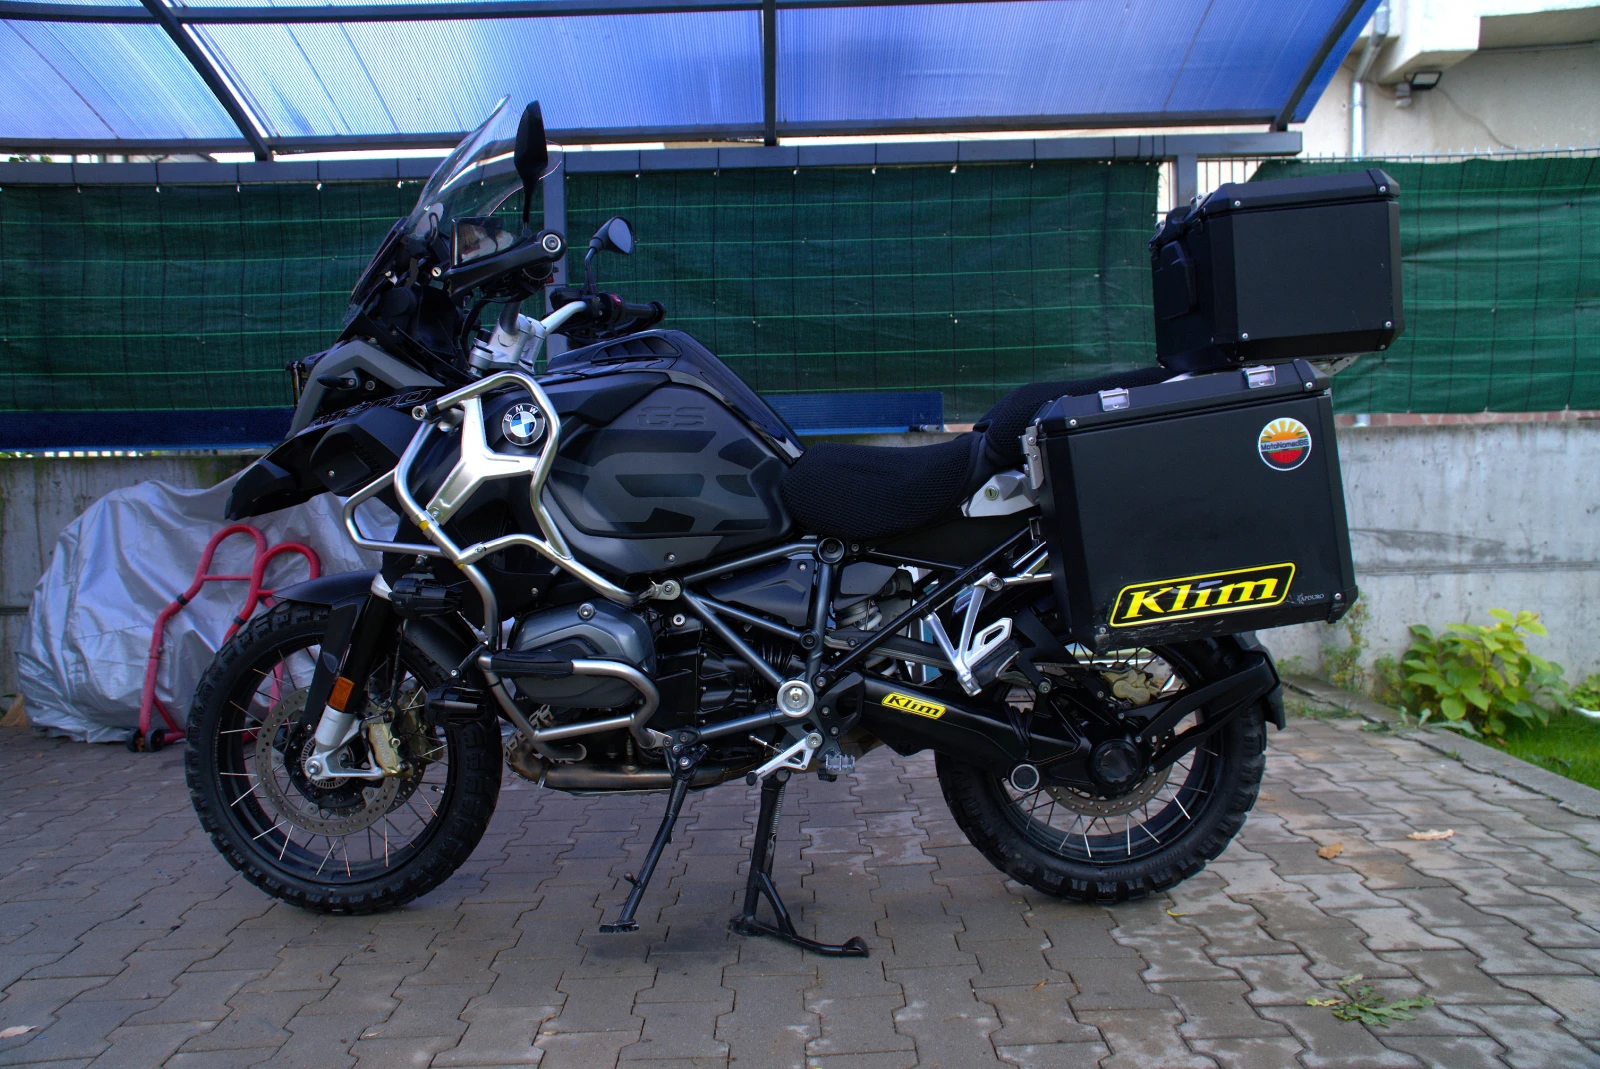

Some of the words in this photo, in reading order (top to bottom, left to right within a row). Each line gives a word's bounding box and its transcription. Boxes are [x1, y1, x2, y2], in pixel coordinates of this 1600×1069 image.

[504, 405, 539, 422] BMW
[637, 406, 706, 428] GS
[1121, 578, 1279, 619] Klim
[888, 695, 940, 715] Klim
